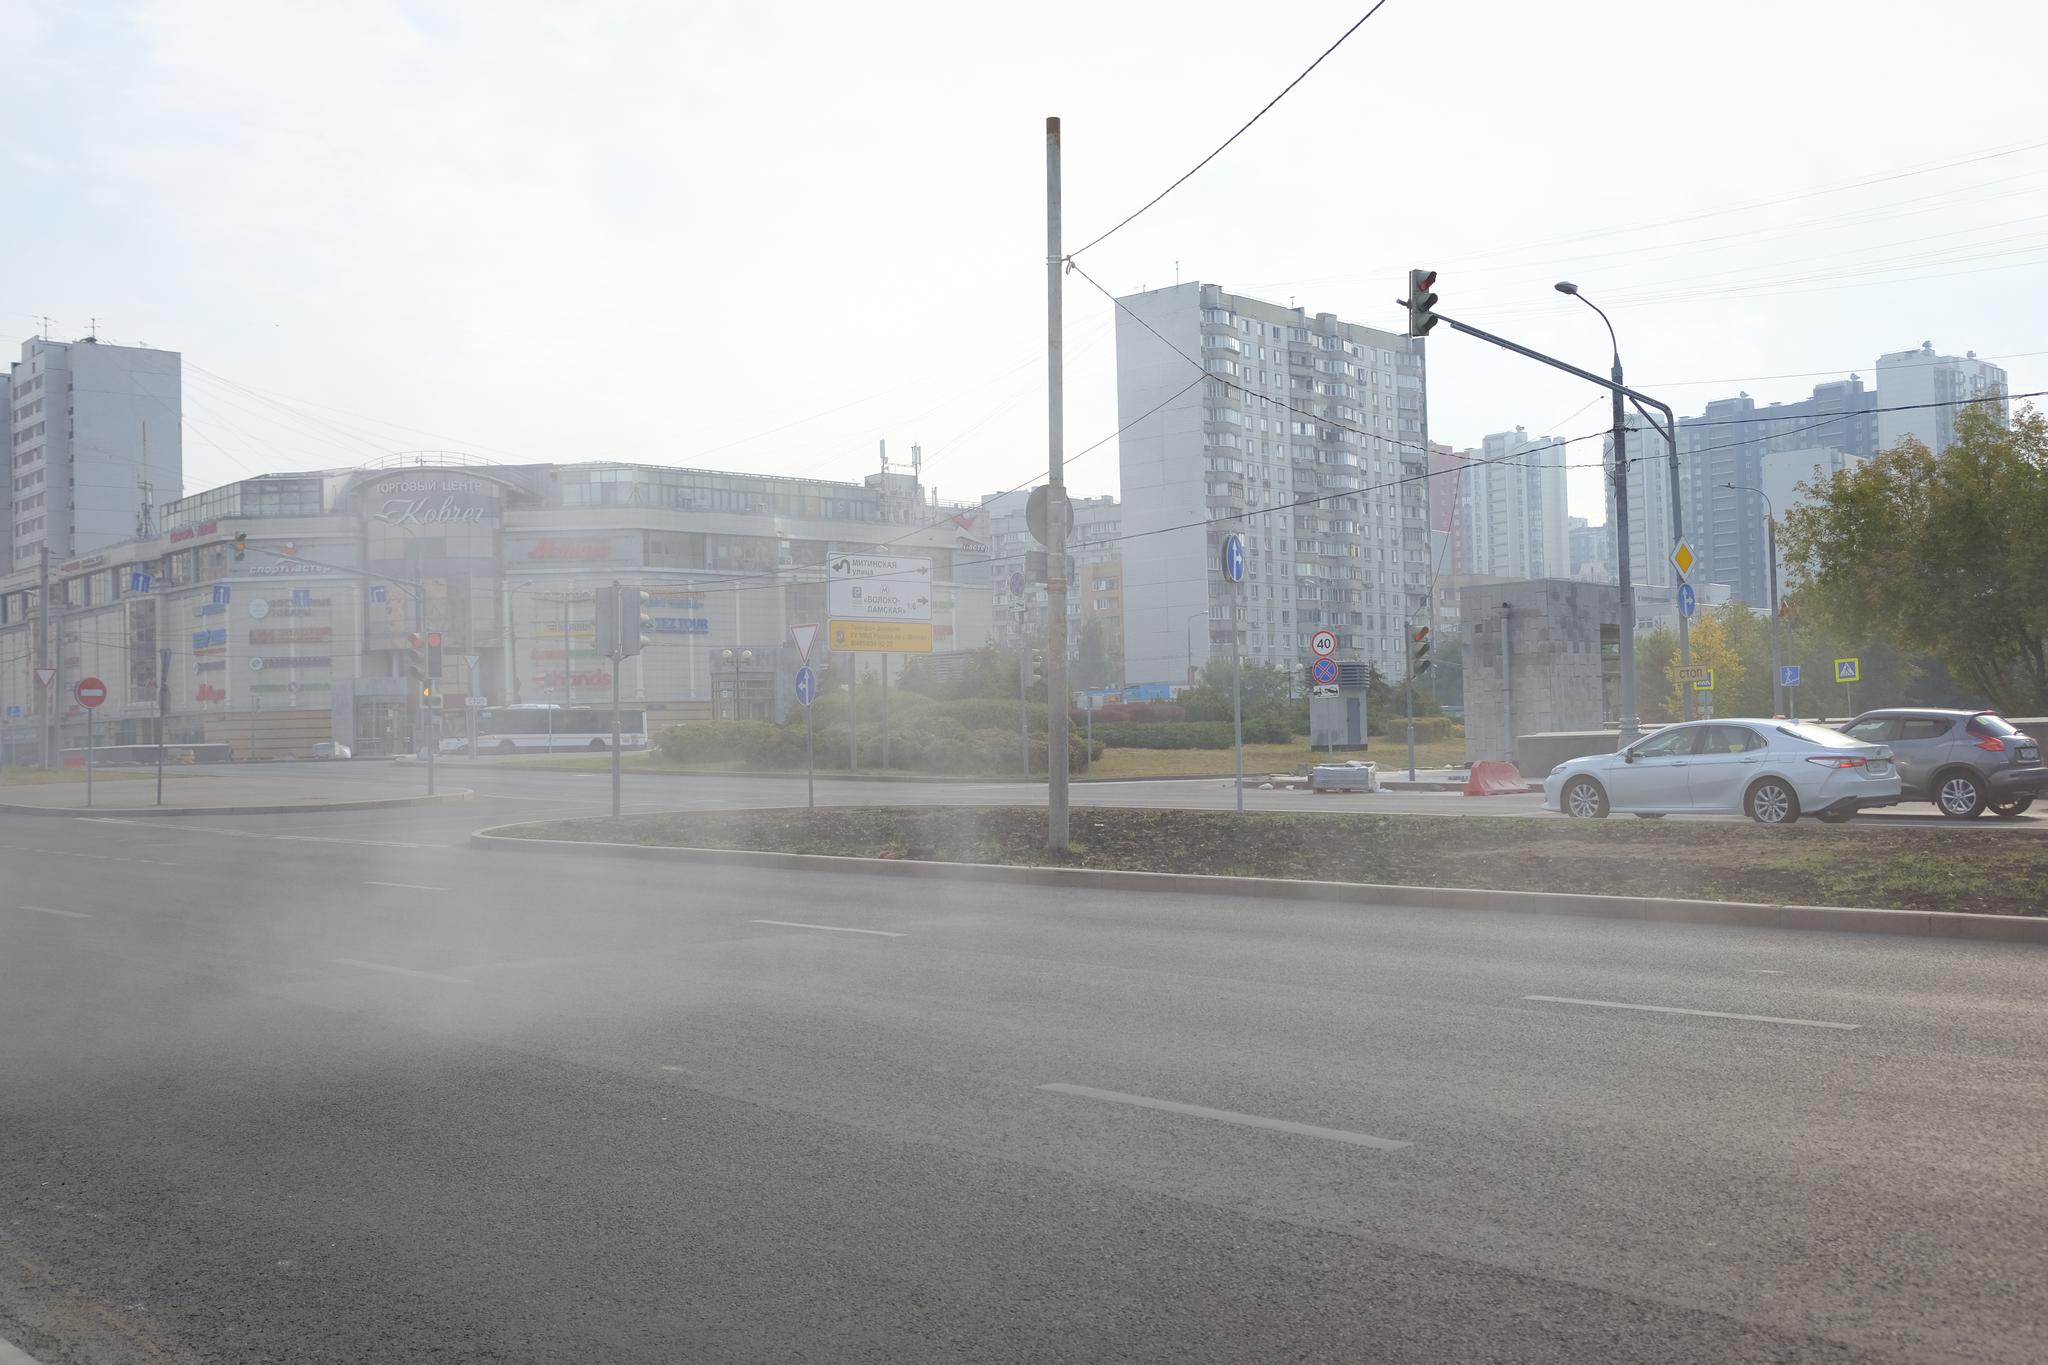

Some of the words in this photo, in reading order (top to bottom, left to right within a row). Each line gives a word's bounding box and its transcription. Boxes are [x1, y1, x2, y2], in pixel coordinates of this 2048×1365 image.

[376, 480, 436, 493] ТОРГОВЫЙ
[442, 480, 482, 491] ЦЕНТР
[852, 560, 897, 568] МИТИНСКАЯ
[864, 596, 900, 604] «ВОЛОКО-
[655, 618, 677, 629] TEZ
[677, 618, 709, 629] TOUR
[1317, 638, 1331, 649] 40
[1680, 669, 1703, 679] СТОП
